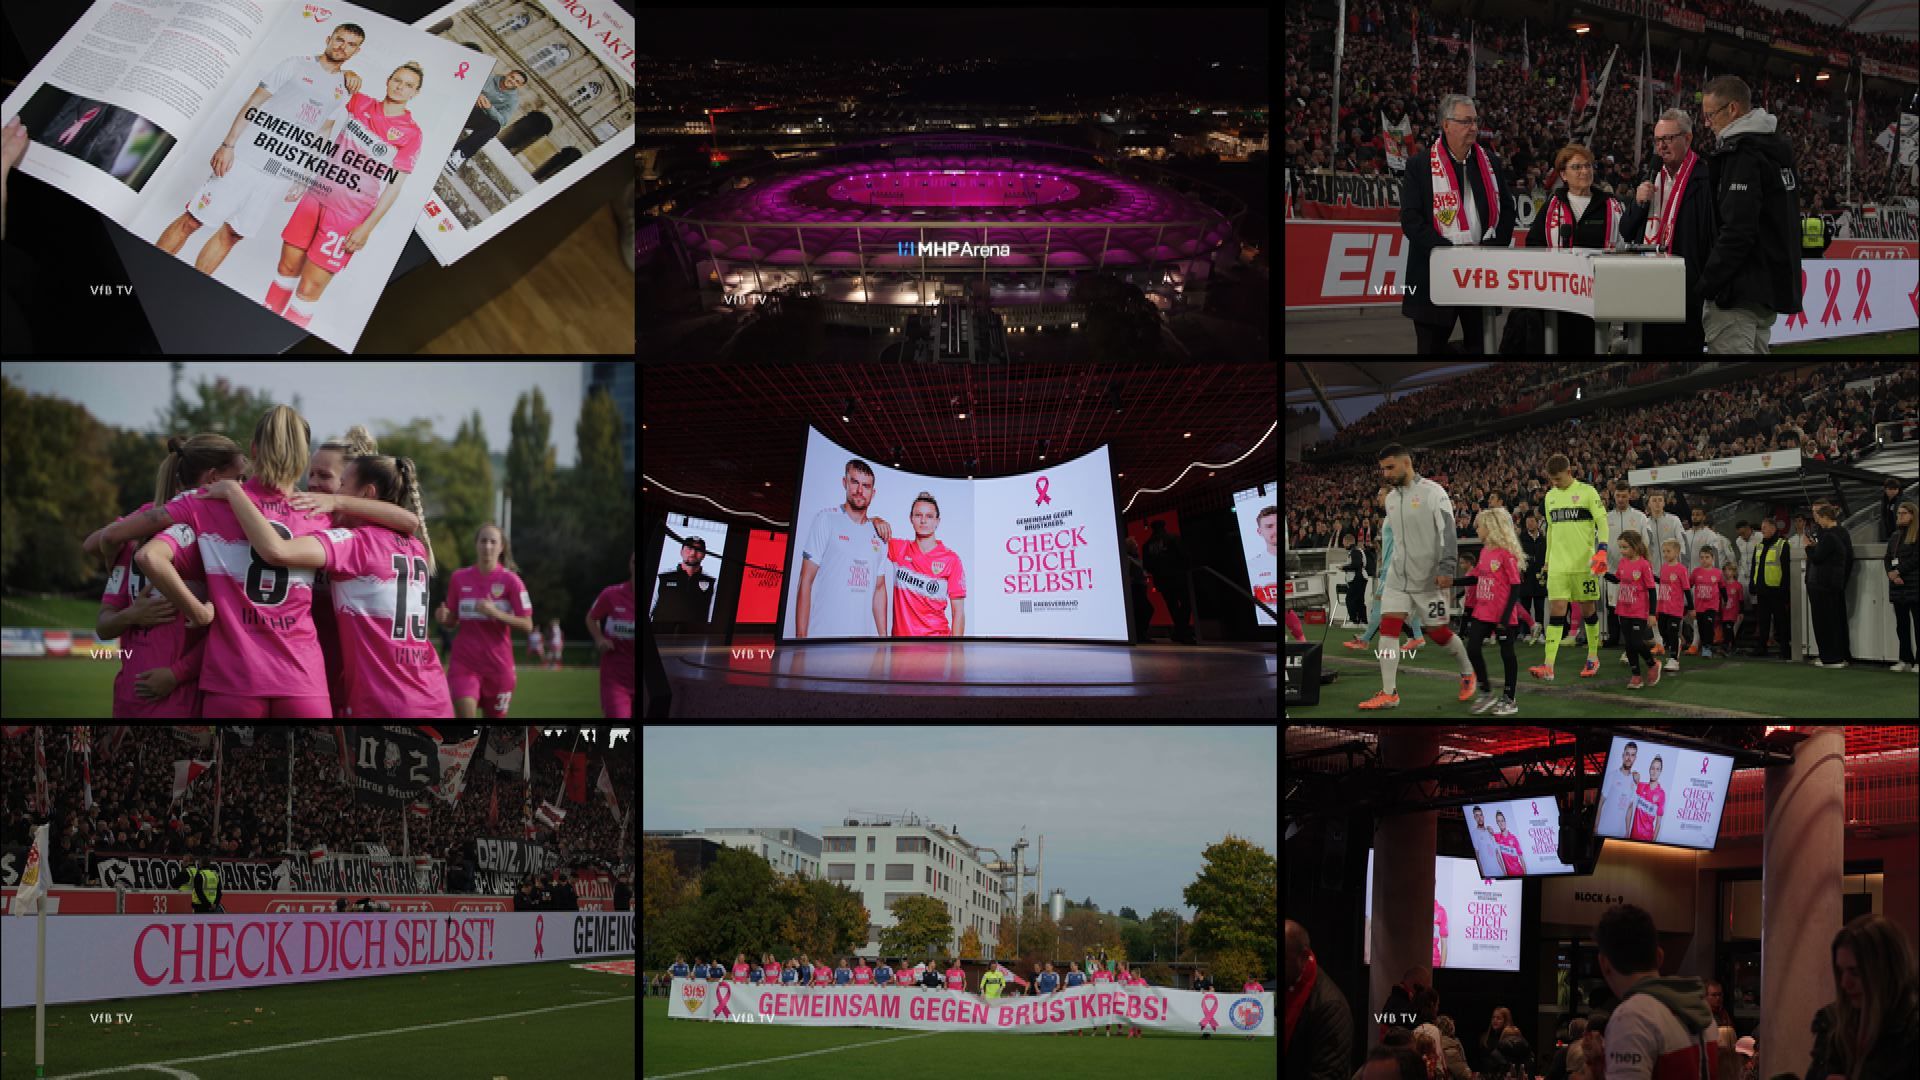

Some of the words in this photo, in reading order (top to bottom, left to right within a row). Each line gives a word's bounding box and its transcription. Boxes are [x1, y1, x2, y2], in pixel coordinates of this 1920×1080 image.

[244, 107, 340, 159] GEMEINSAM
[341, 149, 399, 184] GEGEN
[253, 132, 361, 192] BRUSTKREBS.
[1320, 233, 1410, 297] EH
[1452, 268, 1499, 289] VfB
[1016, 514, 1052, 525] GEMEINSAM
[1053, 509, 1073, 520] GEGEN
[1005, 526, 1088, 555] CHECK
[1018, 549, 1077, 573] DICH
[1003, 567, 1093, 594] SELBST!
[1582, 580, 1596, 594] 33
[391, 553, 430, 642] 13
[1428, 601, 1446, 618] 26
[1683, 787, 1715, 802] CHECK
[476, 838, 520, 873] DENIZ,
[152, 896, 167, 913] 33
[1575, 891, 1603, 903] BLOCK
[1467, 902, 1508, 917] CHECK
[1473, 914, 1501, 928] DICH
[1465, 927, 1508, 941] SELBST!
[133, 921, 294, 987] CHECK
[301, 920, 388, 975] DICH
[393, 918, 495, 967] SELBST!
[758, 992, 900, 1019] GEMEINSAM
[910, 996, 990, 1025] GEGEN
[998, 991, 1168, 1027] BRUSTKREBS!
